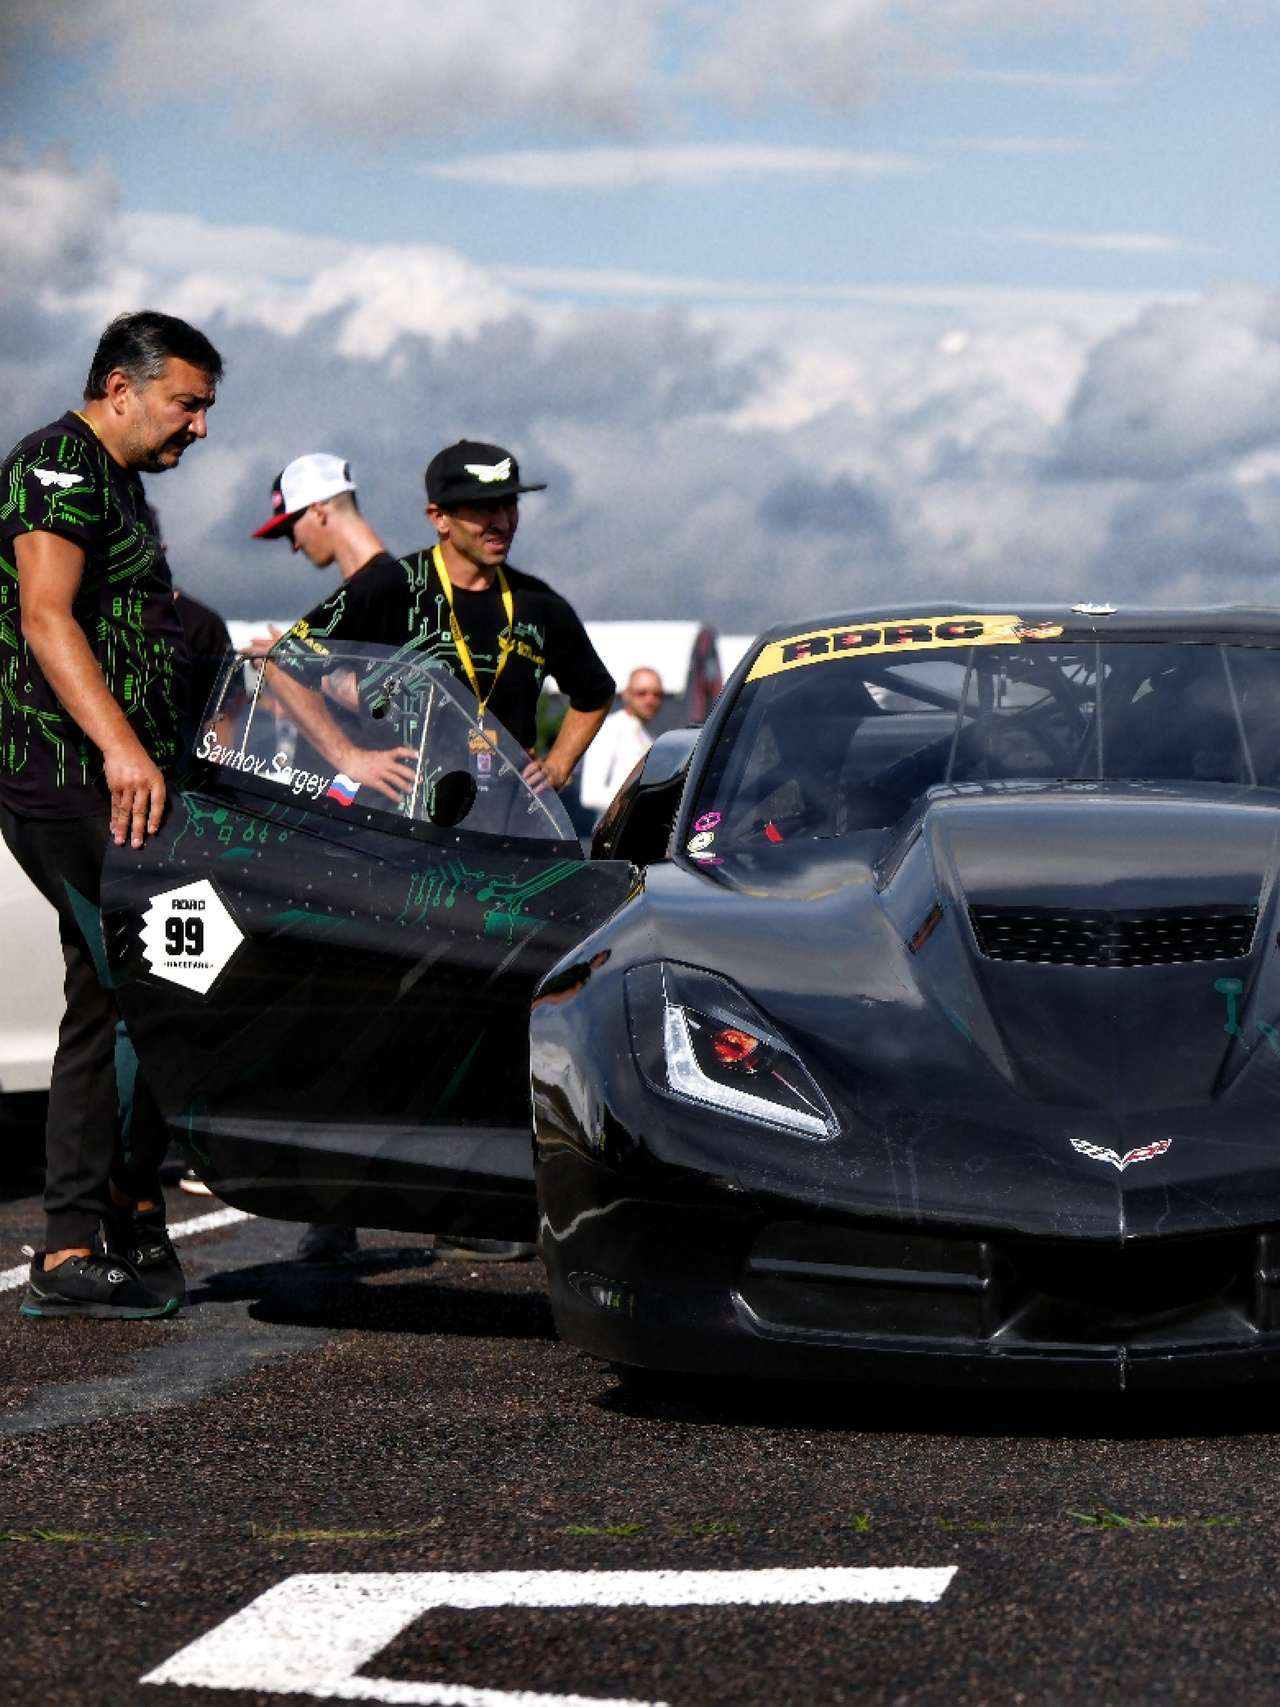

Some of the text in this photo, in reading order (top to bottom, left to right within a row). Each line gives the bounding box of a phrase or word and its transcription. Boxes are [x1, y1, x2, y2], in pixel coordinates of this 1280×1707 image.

[783, 621, 984, 664] RDRC
[196, 731, 329, 800] Savinov Sergey
[165, 917, 204, 956] 99
